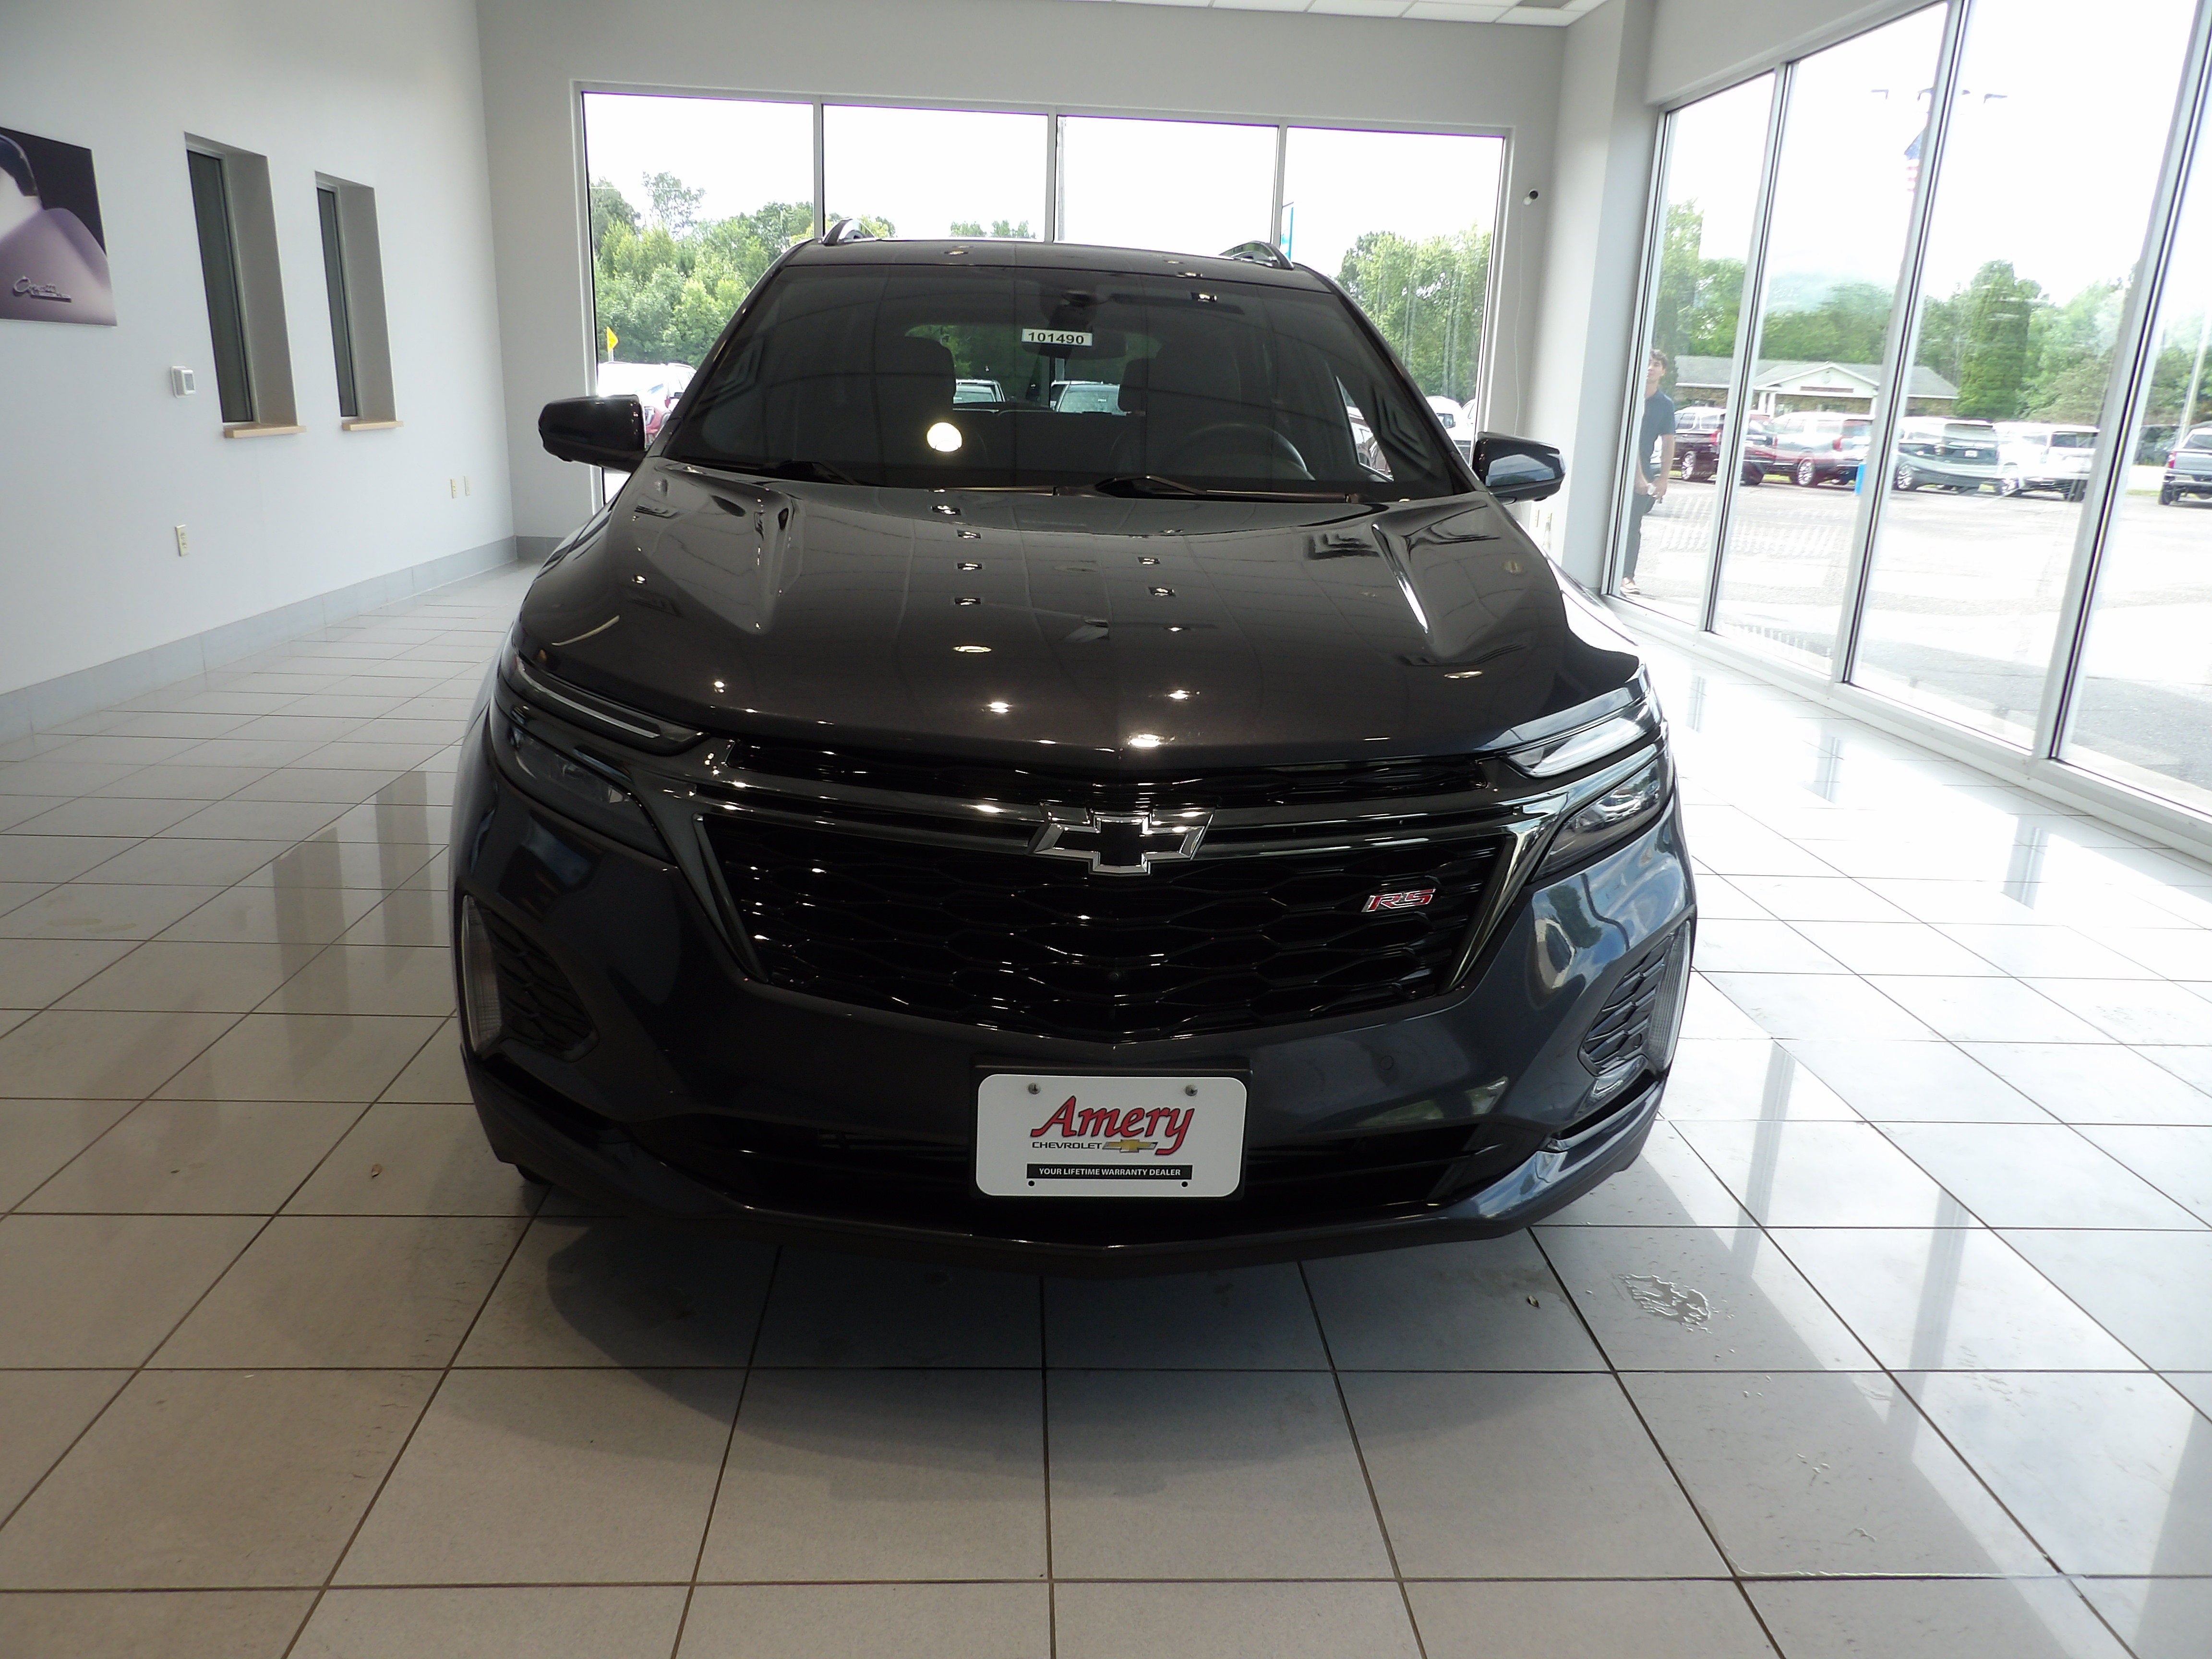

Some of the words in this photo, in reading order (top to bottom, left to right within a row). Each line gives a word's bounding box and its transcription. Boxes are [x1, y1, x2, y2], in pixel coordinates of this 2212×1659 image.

[1028, 332, 1084, 344] 101490
[1360, 889, 1436, 912] RS
[1030, 1095, 1195, 1155] Amery
[1032, 1141, 1103, 1149] CHEVROLET
